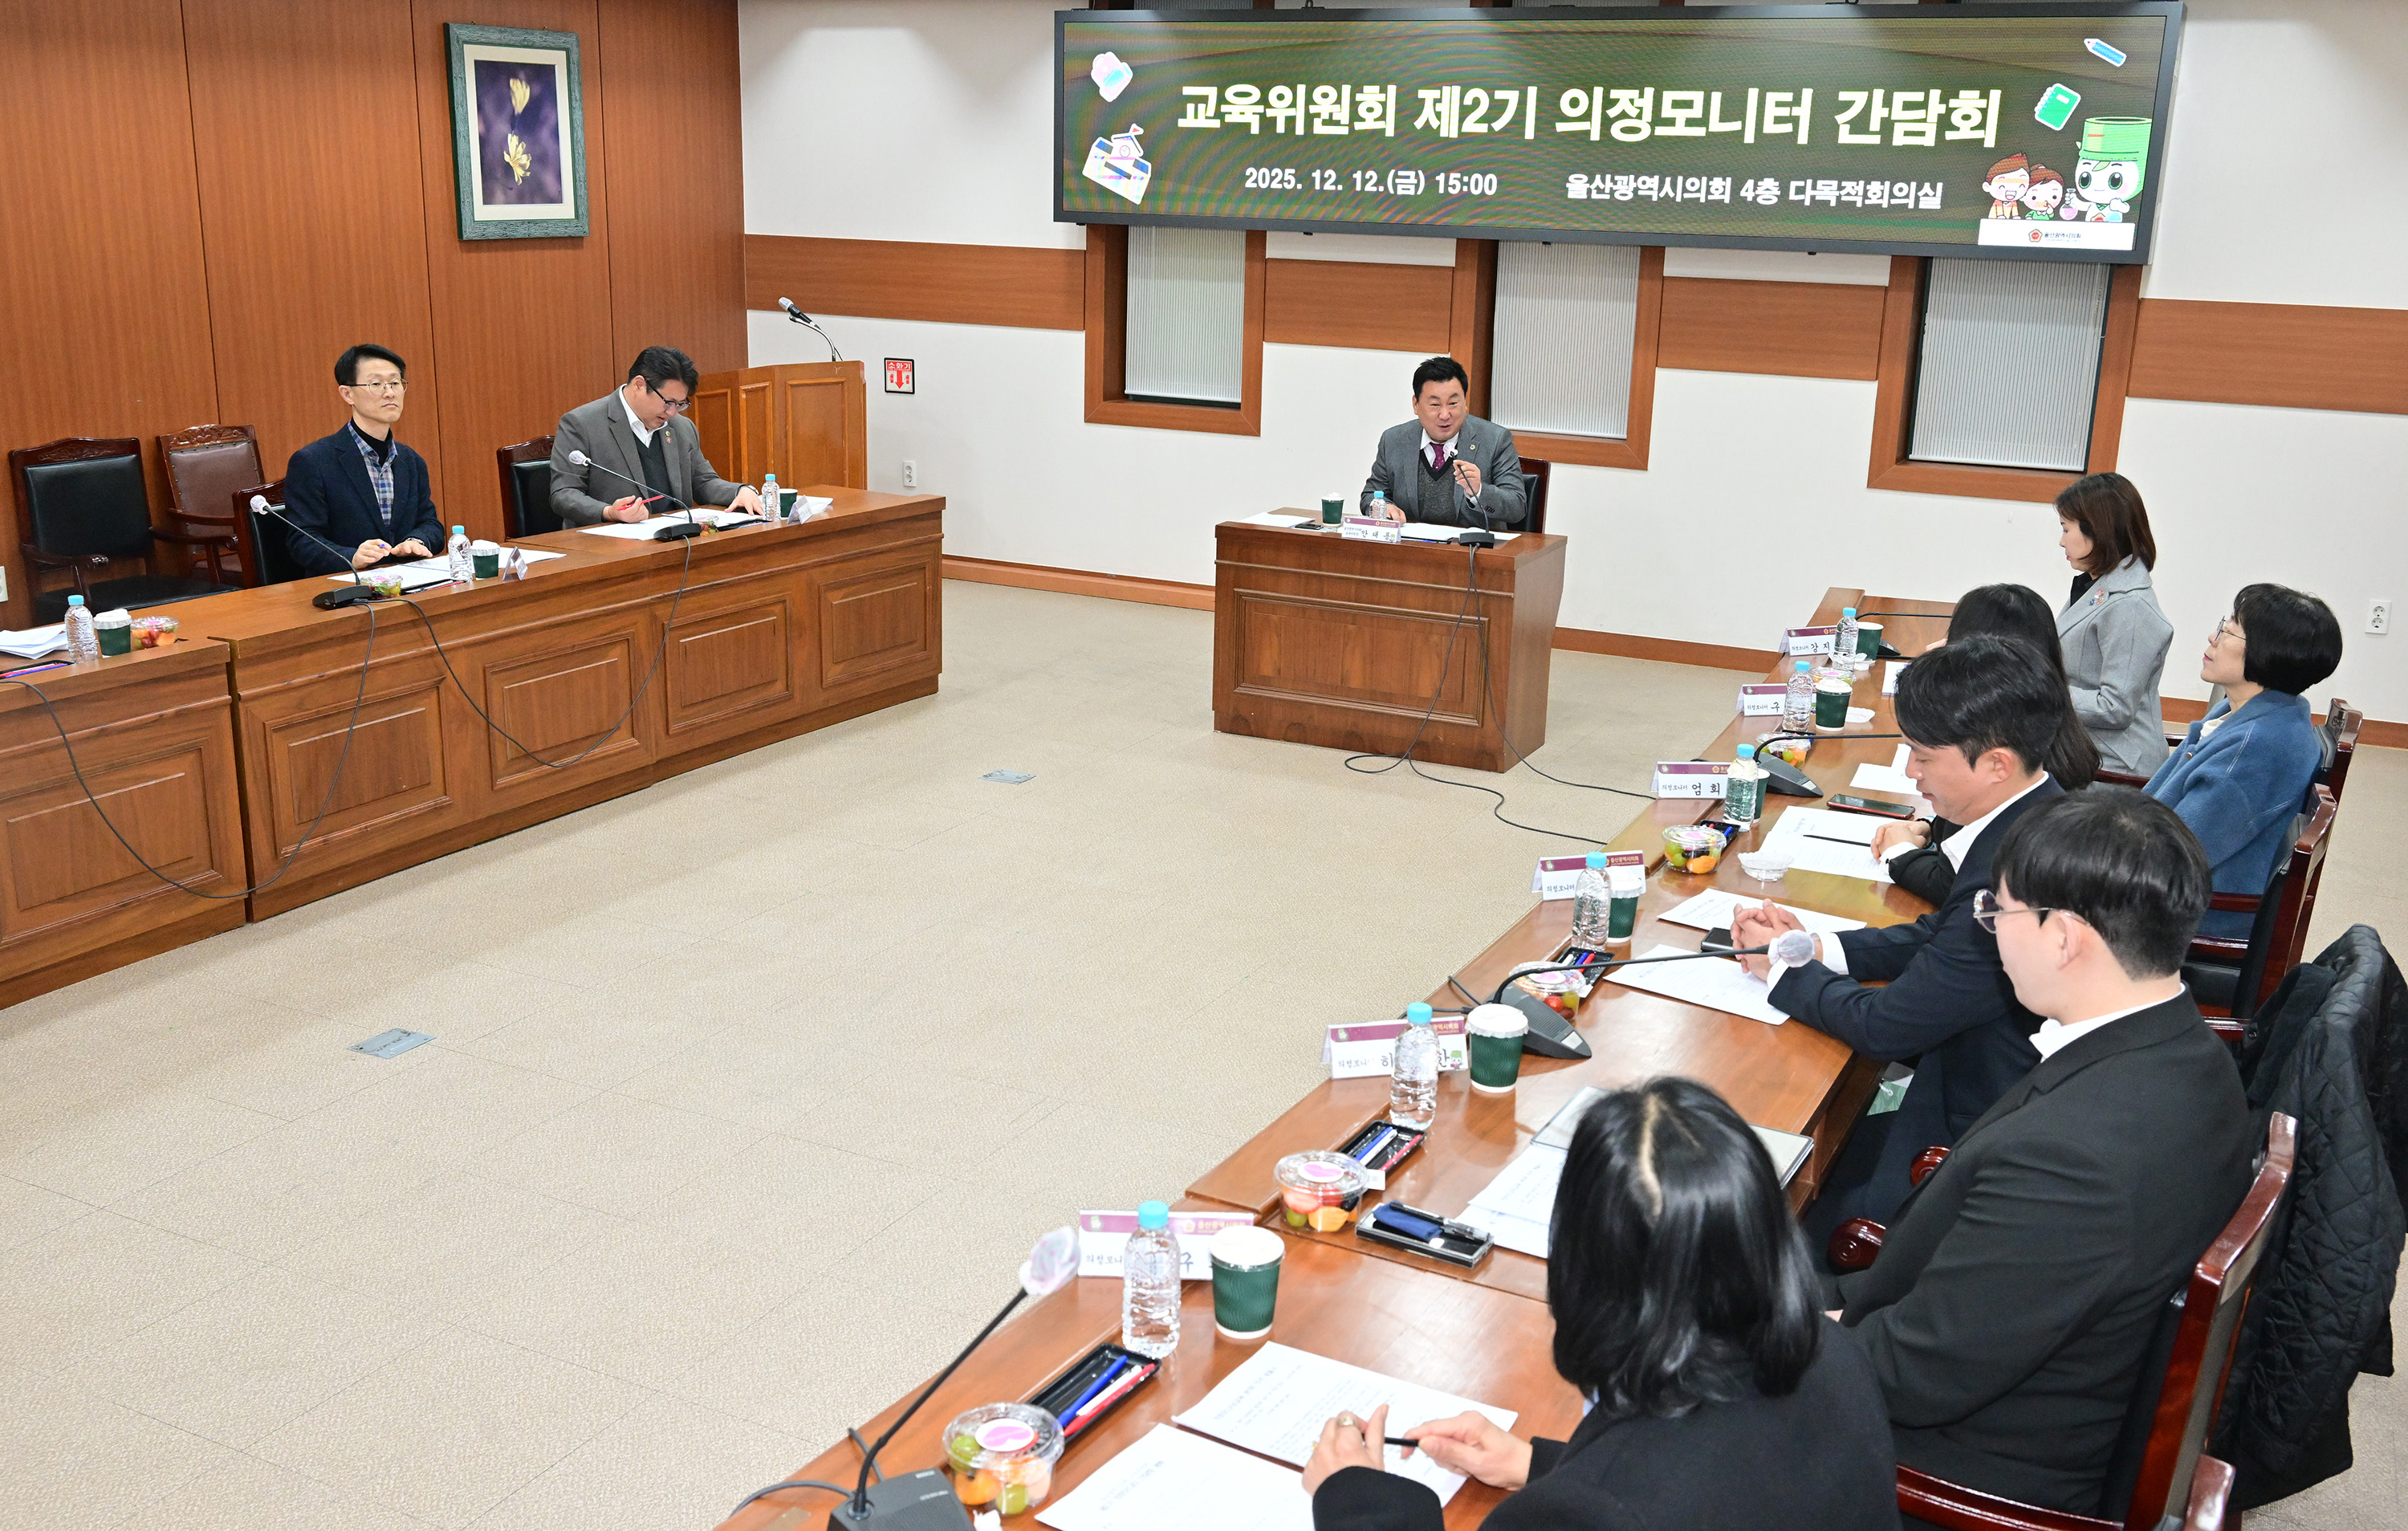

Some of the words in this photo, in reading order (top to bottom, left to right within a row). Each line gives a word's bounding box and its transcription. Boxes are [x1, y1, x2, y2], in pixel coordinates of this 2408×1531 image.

[1178, 83, 1397, 137] 교육위원회
[1413, 85, 1538, 140] 제2기
[1555, 86, 1814, 145] 의정모니터
[1834, 88, 2002, 148] 간담회
[1244, 167, 1303, 189] 2025.
[1312, 169, 1343, 191] 12.
[1352, 169, 1426, 196] 12.(금)
[1435, 172, 1498, 196] 15:00
[1565, 173, 1732, 204] 울산광역시의회
[1739, 177, 1781, 206] 4층
[1788, 178, 1943, 210] 다목적회의실
[1771, 702, 1780, 713] 구
